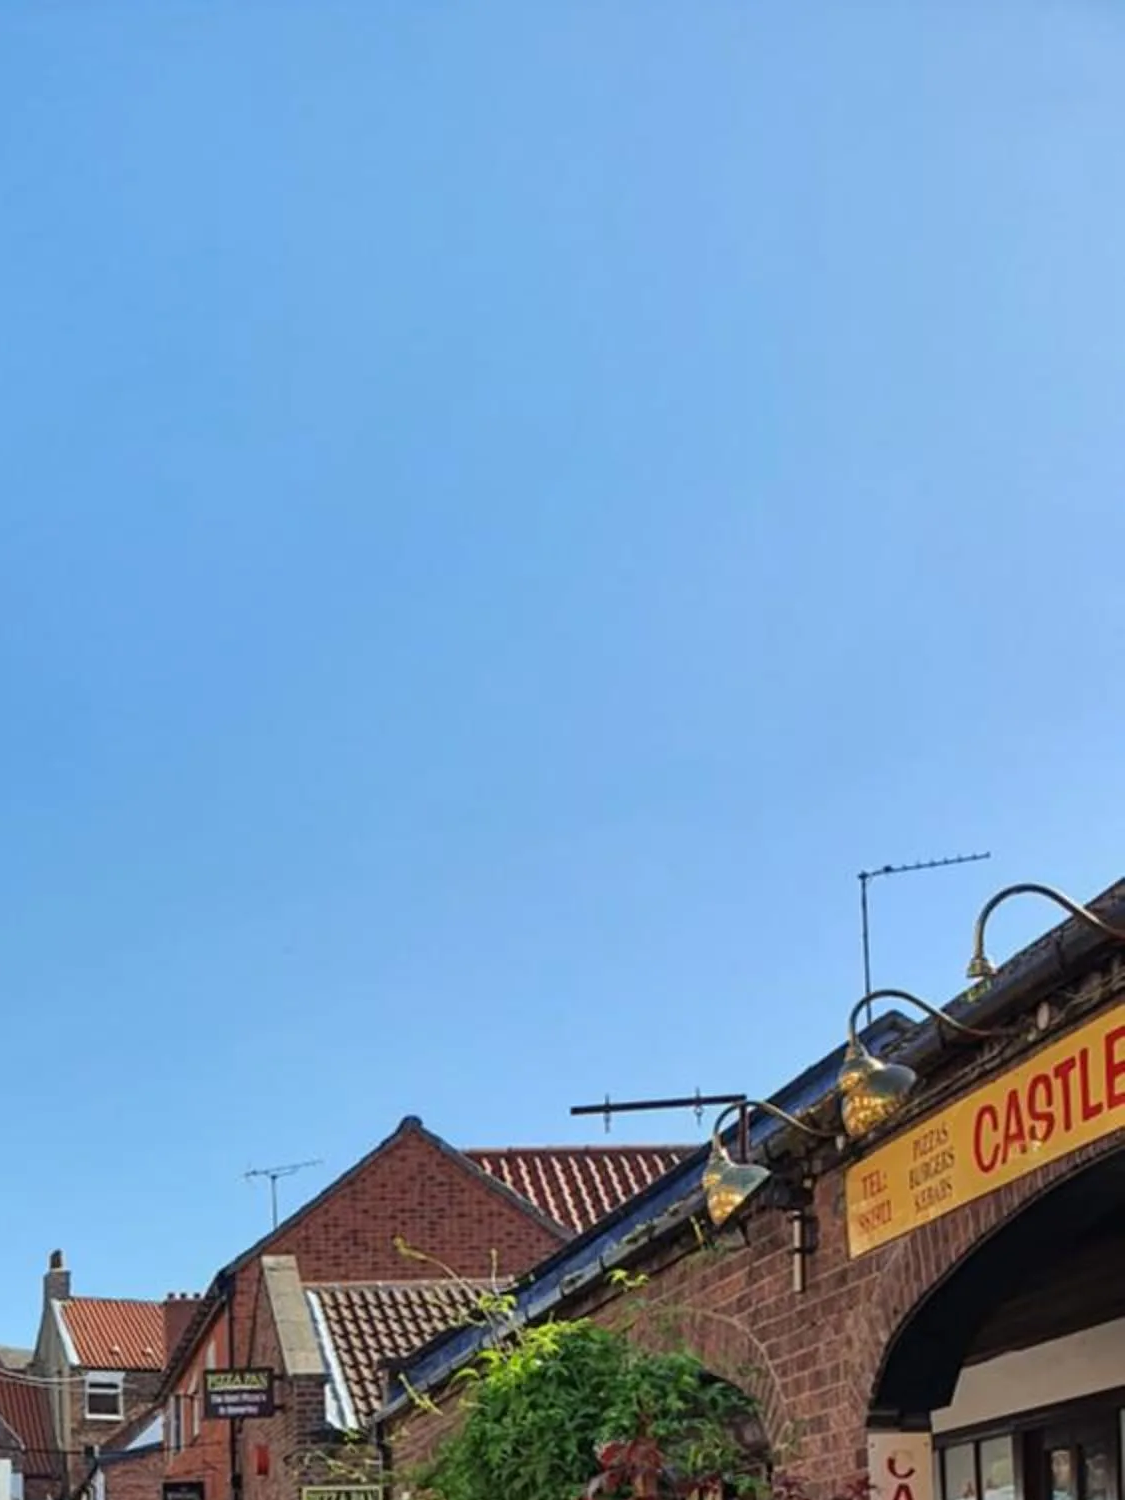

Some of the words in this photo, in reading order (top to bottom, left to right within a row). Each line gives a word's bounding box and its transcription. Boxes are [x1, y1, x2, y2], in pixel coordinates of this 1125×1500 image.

[973, 1024, 1125, 1174] CASTLE
[912, 1122, 949, 1162] PIZZAS
[908, 1147, 955, 1191] BURGERS
